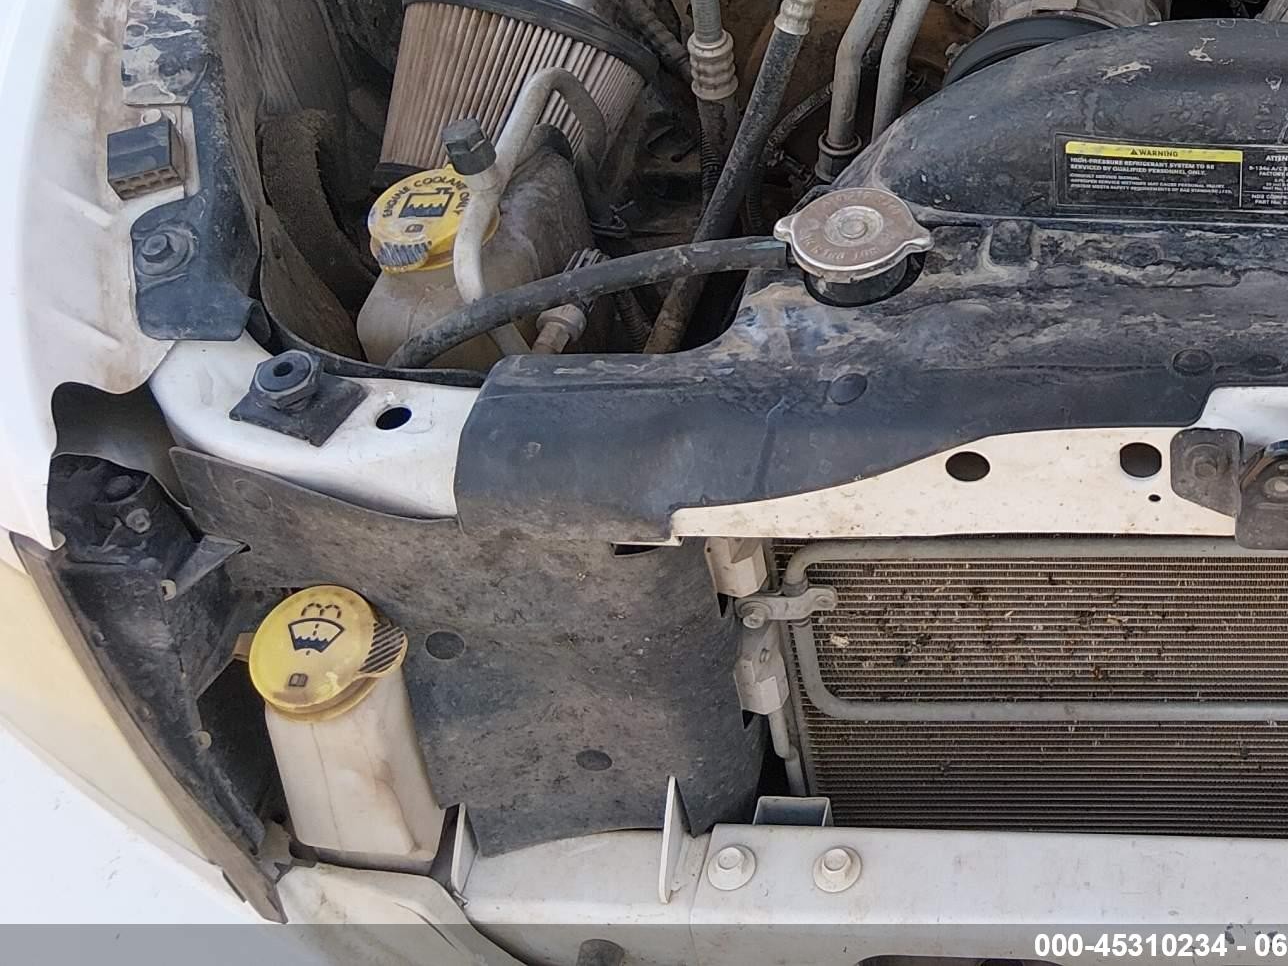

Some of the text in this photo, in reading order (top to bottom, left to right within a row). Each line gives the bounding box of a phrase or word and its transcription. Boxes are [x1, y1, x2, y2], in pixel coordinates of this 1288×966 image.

[1140, 148, 1178, 157] WARNING
[1070, 157, 1123, 165] HIGH-PRESSURE
[1124, 160, 1168, 168] REFRIGERANT
[414, 176, 468, 190] COOLANT
